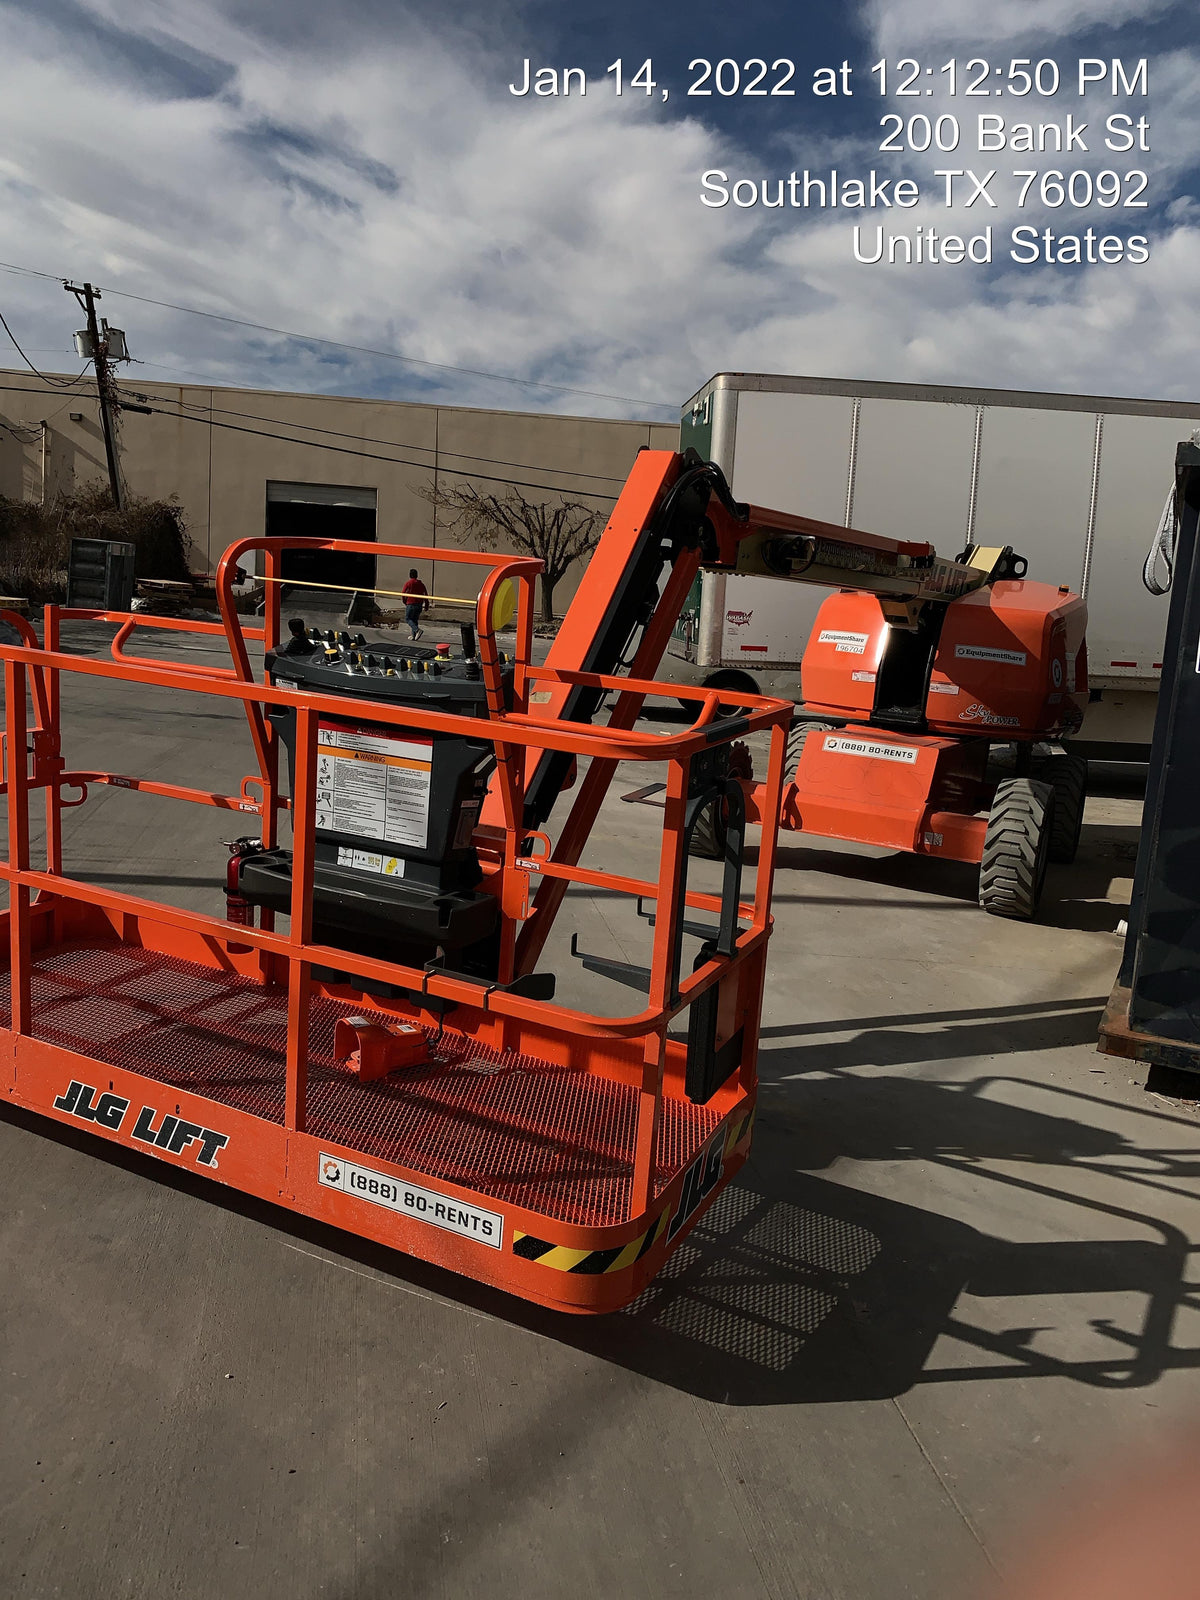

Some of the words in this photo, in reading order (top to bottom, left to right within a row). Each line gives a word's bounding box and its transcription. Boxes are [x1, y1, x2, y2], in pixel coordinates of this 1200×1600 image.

[825, 633, 865, 643] EquipmentShare
[836, 643, 864, 654] 196704
[965, 648, 1023, 662] EquipmentShare
[959, 703, 990, 722] Sky
[984, 714, 1021, 727] POWER
[359, 752, 386, 763] WARNING
[841, 742, 866, 752] (888)
[868, 746, 913, 759] 80-RENTS
[52, 1079, 131, 1132] JLG
[130, 1105, 232, 1169] LIFT
[665, 1122, 728, 1246] JLG
[349, 1171, 397, 1203] (888)
[403, 1193, 495, 1237] 80-RENTS
